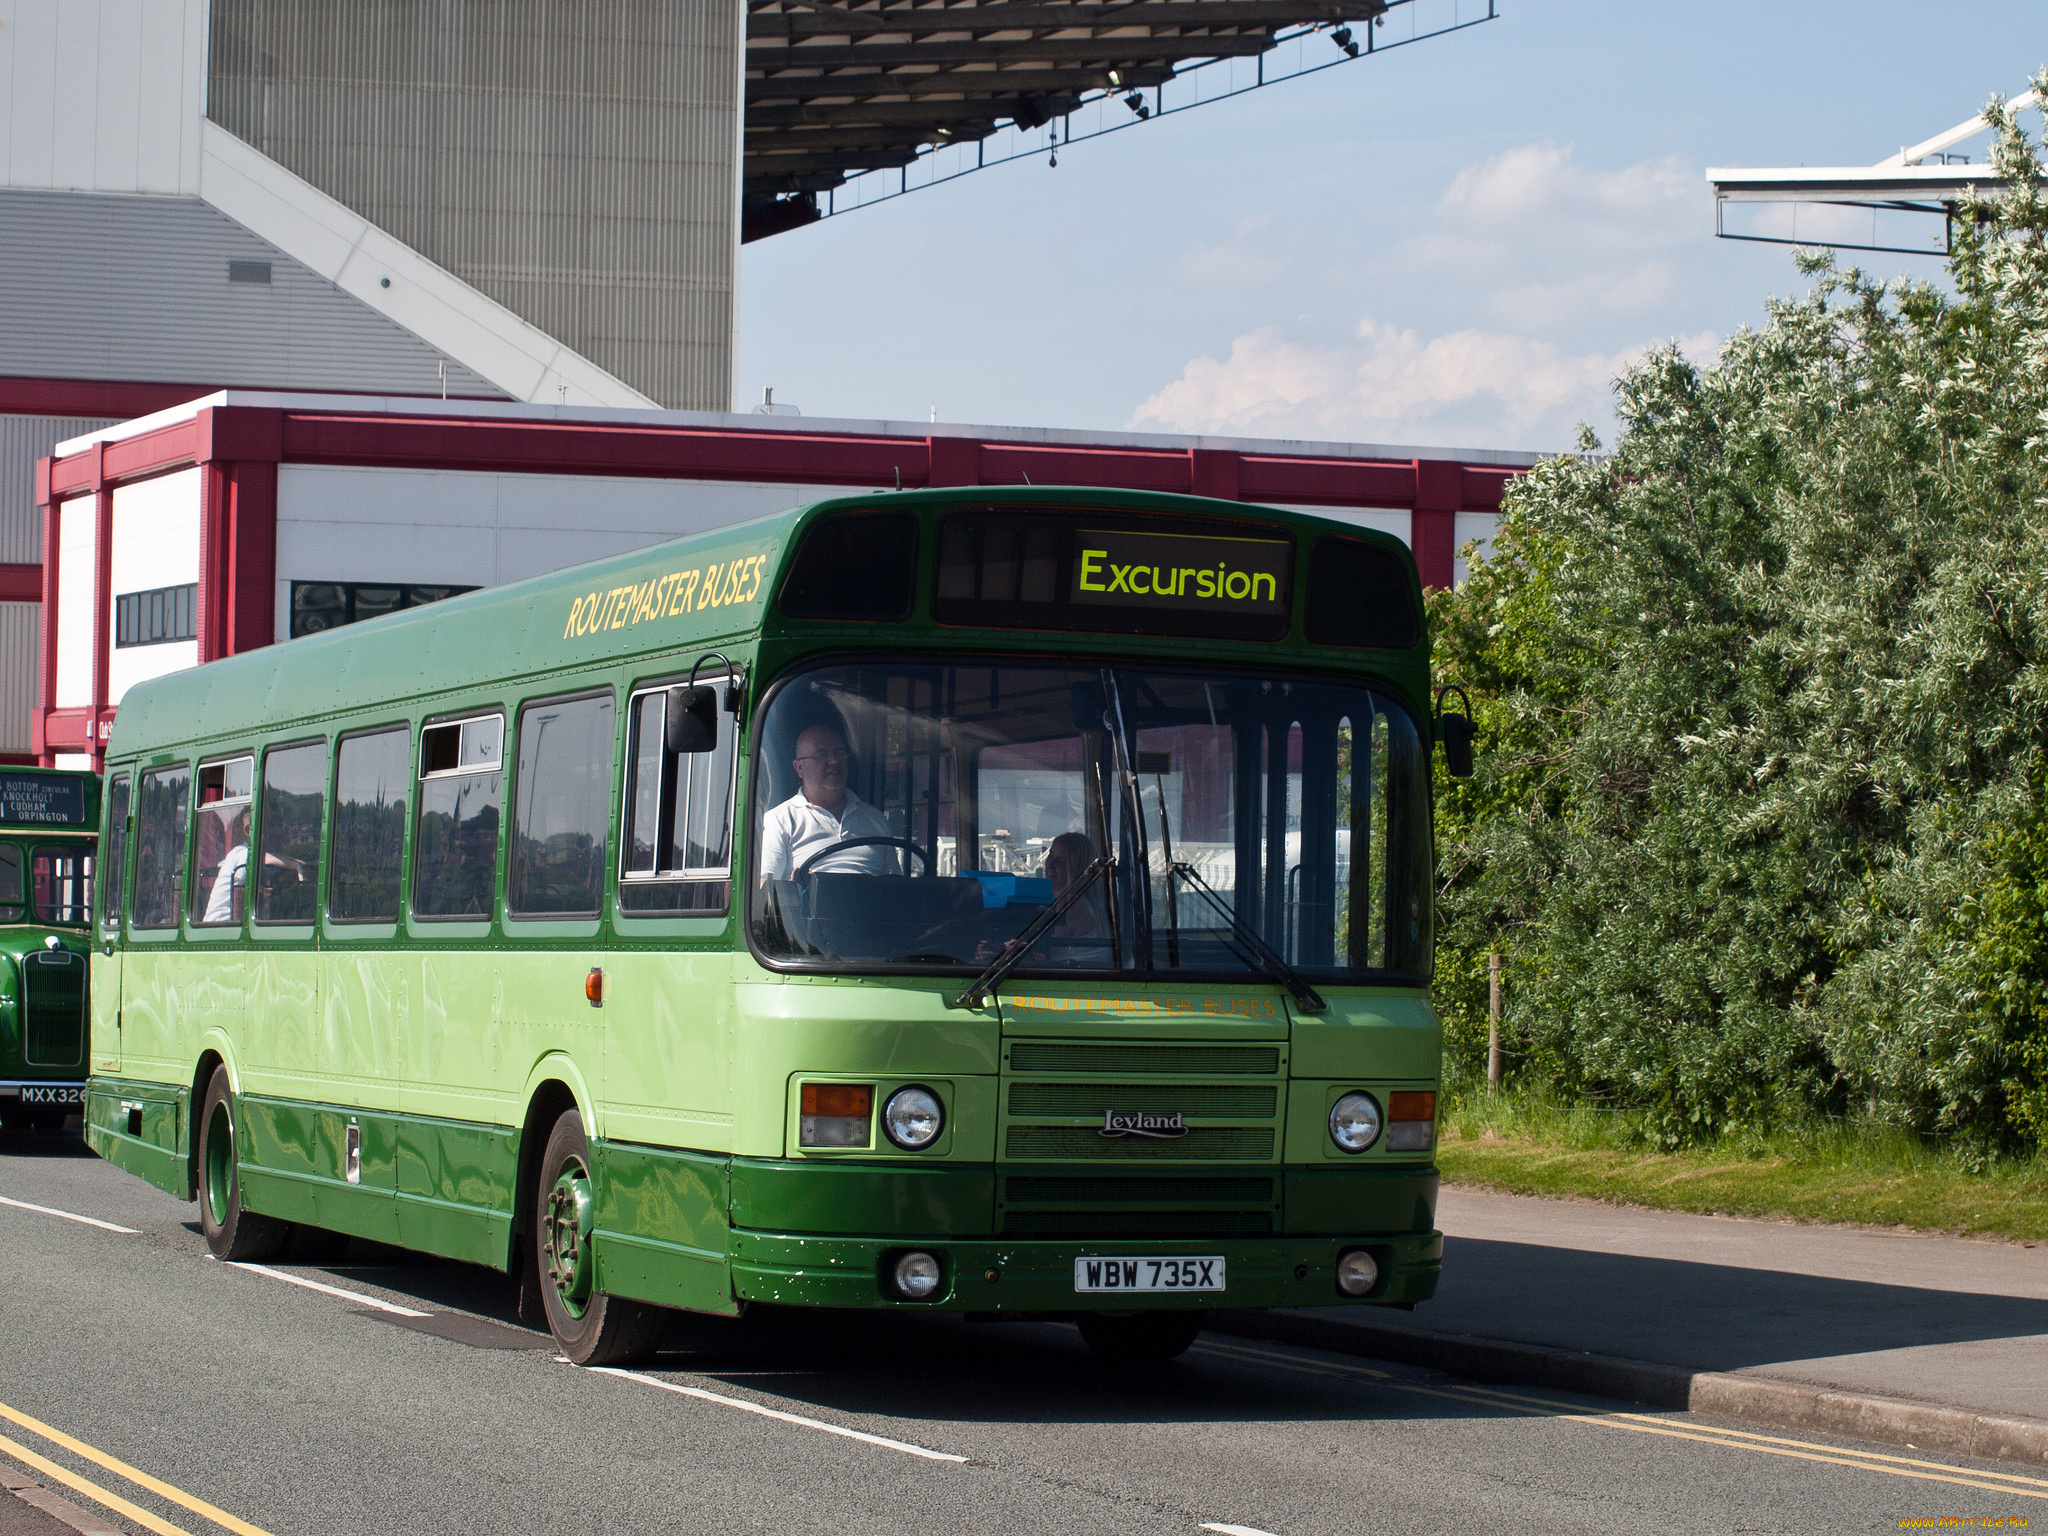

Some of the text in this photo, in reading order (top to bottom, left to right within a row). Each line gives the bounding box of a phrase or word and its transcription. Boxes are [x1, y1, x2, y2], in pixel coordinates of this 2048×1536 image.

[1079, 549, 1276, 601] Excursion
[563, 554, 767, 640] ROUTEMASTER BUSES
[3, 791, 53, 803] KNOCKHOLT
[6, 781, 38, 792] BOTTOM
[41, 786, 70, 794] CIRCULAR
[10, 802, 46, 811] CUDHAM
[18, 811, 68, 822] ORPINGTON
[1013, 996, 1275, 1016] ROUTEMASTER BUSES
[1101, 1109, 1186, 1135] Leyland
[1086, 1261, 1214, 1287] WBW 735X
